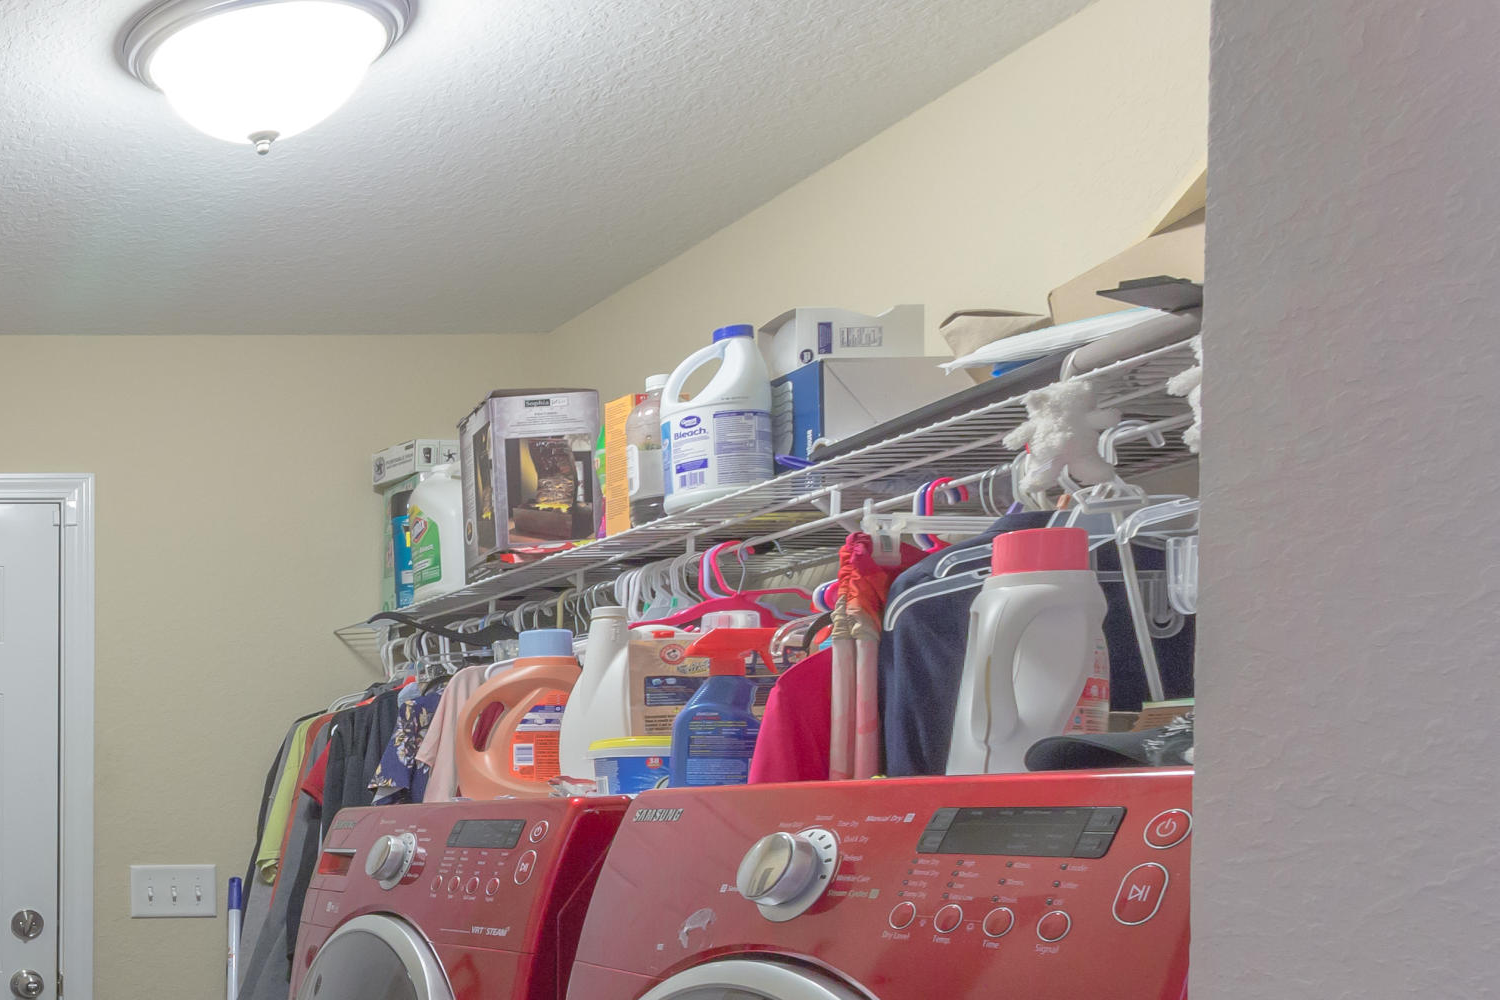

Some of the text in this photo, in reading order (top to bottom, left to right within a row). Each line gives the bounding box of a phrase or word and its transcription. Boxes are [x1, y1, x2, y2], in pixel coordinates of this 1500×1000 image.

[673, 426, 707, 441] Bleach
[633, 808, 684, 822] SAMSUNG
[486, 926, 508, 937] STEAM
[1035, 943, 1060, 955] Signal
